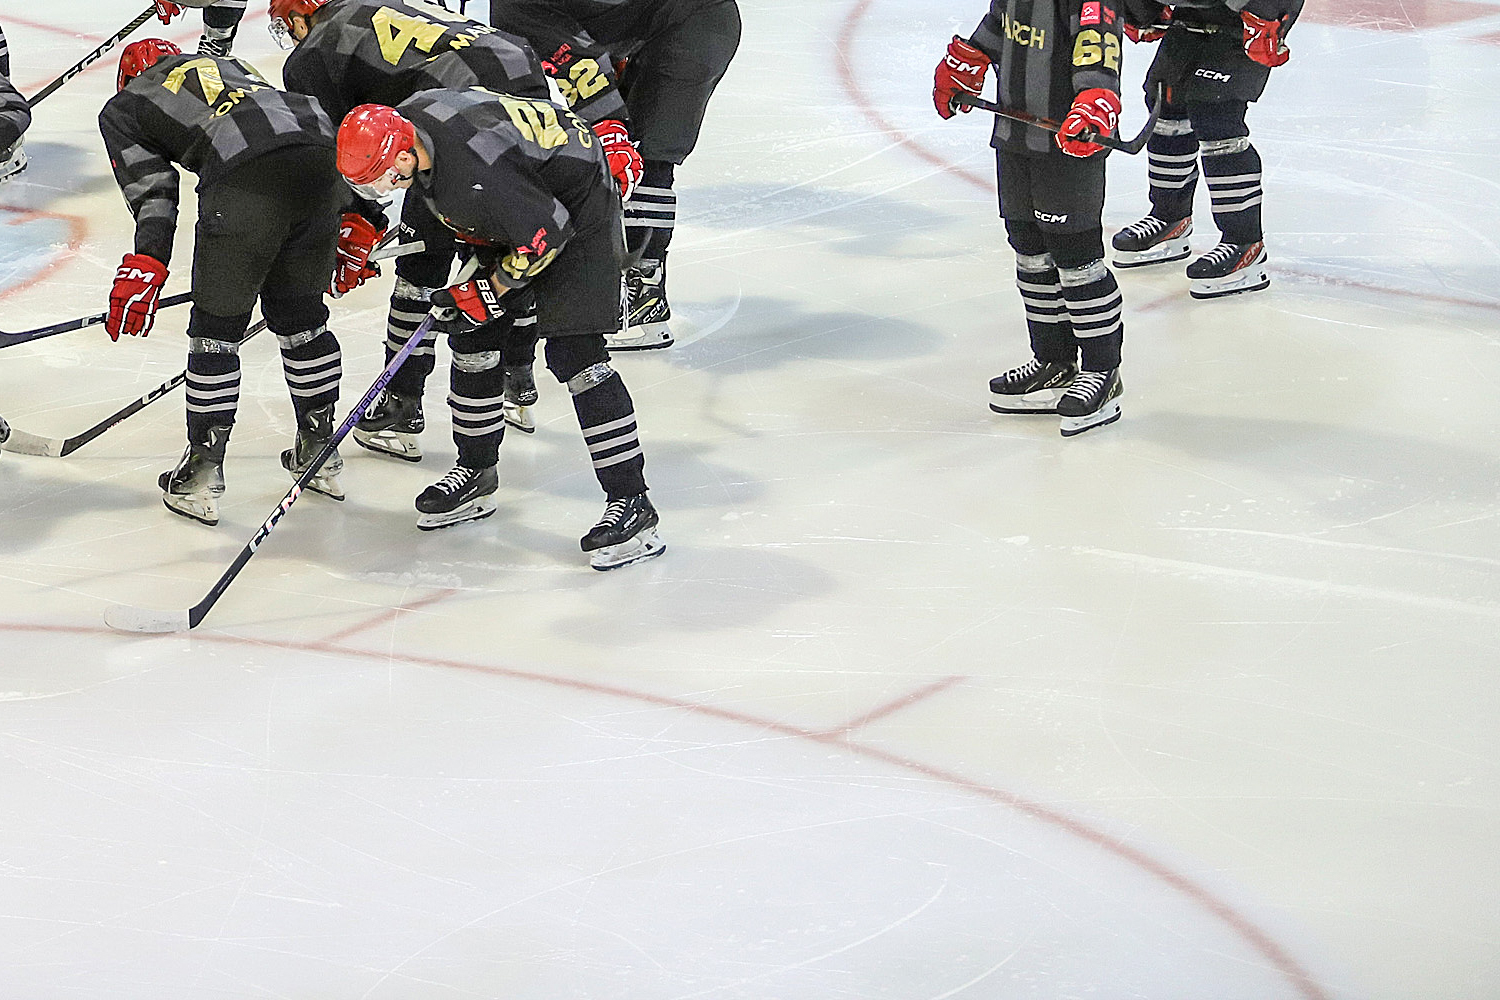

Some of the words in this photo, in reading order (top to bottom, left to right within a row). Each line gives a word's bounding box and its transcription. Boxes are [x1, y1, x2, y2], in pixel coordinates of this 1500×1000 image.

[1002, 13, 1045, 50] ARCH
[62, 34, 120, 83] CCM
[1072, 29, 1122, 72] 62
[1194, 68, 1231, 83] CCM
[600, 132, 640, 149] CCM
[1034, 209, 1069, 224] CCM
[643, 298, 666, 324] CCM
[142, 370, 186, 405] CC
[348, 370, 392, 428] RIBCOR
[249, 484, 301, 553] CCM
